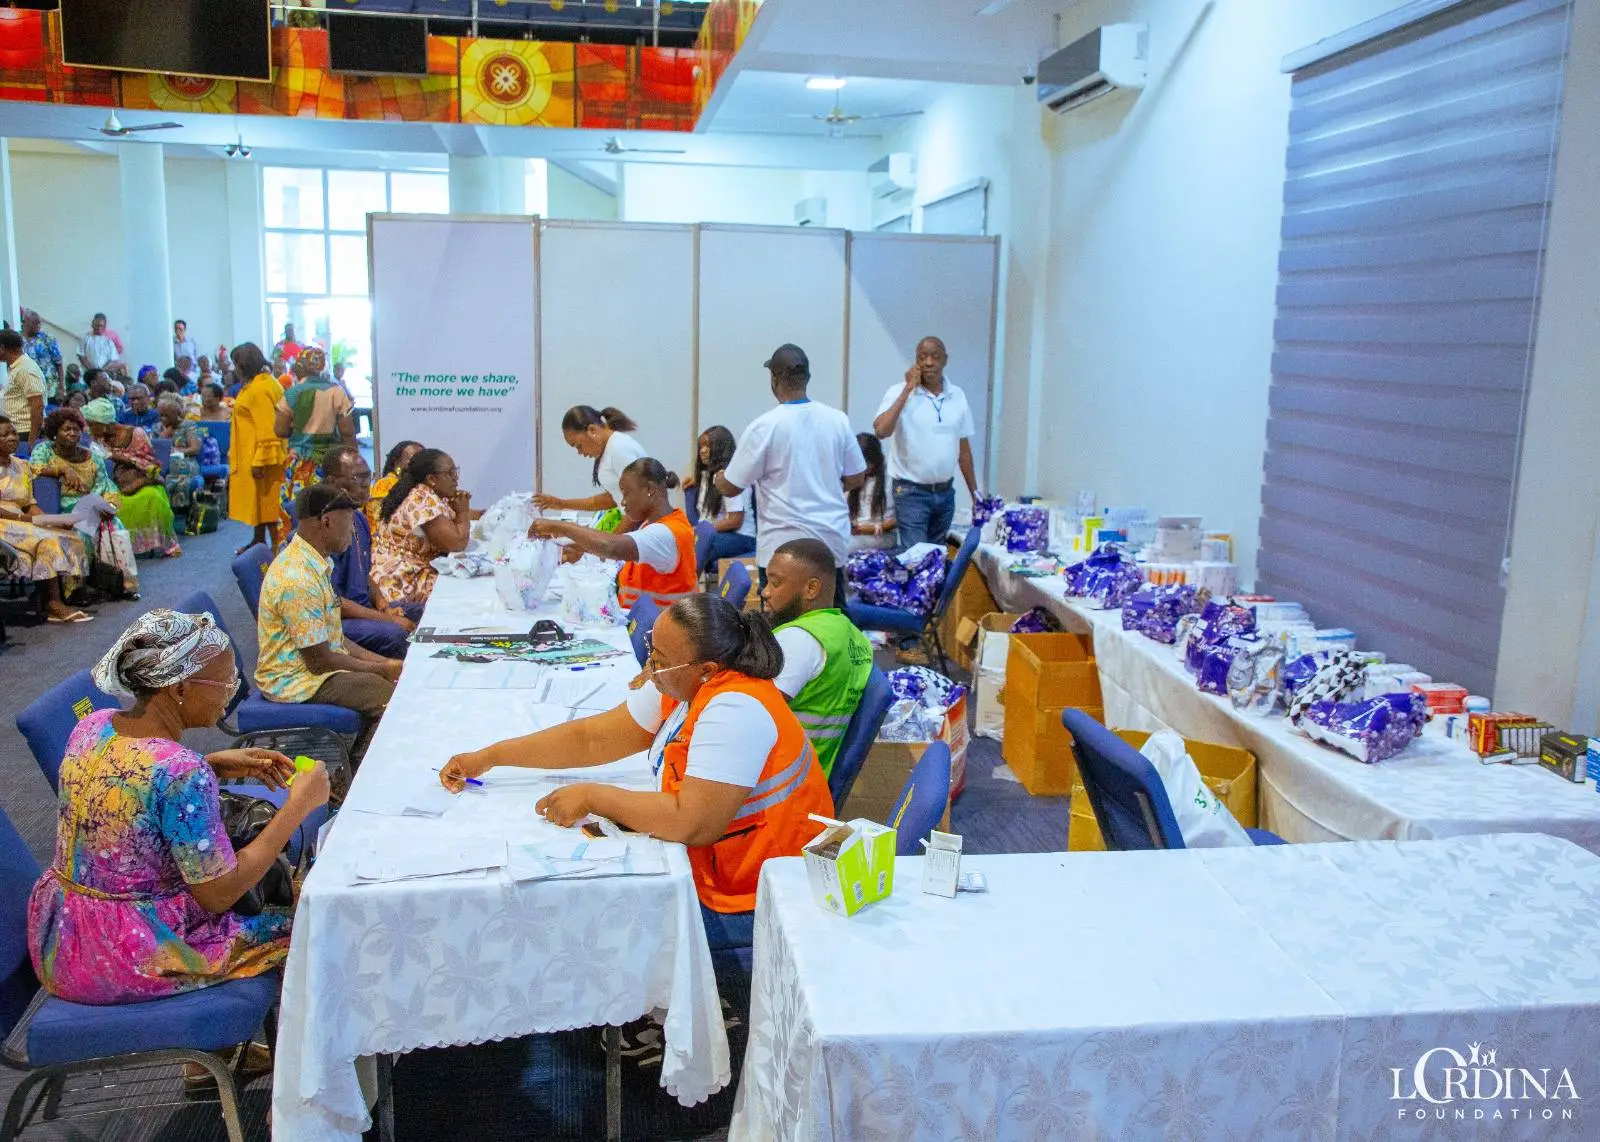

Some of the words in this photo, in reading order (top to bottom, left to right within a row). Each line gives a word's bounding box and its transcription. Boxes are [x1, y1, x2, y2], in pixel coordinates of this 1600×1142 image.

[423, 374, 457, 384] more
[461, 374, 478, 384] we
[482, 373, 519, 385] share,
[396, 386, 417, 397] the
[420, 387, 453, 397] more
[456, 387, 475, 397] we
